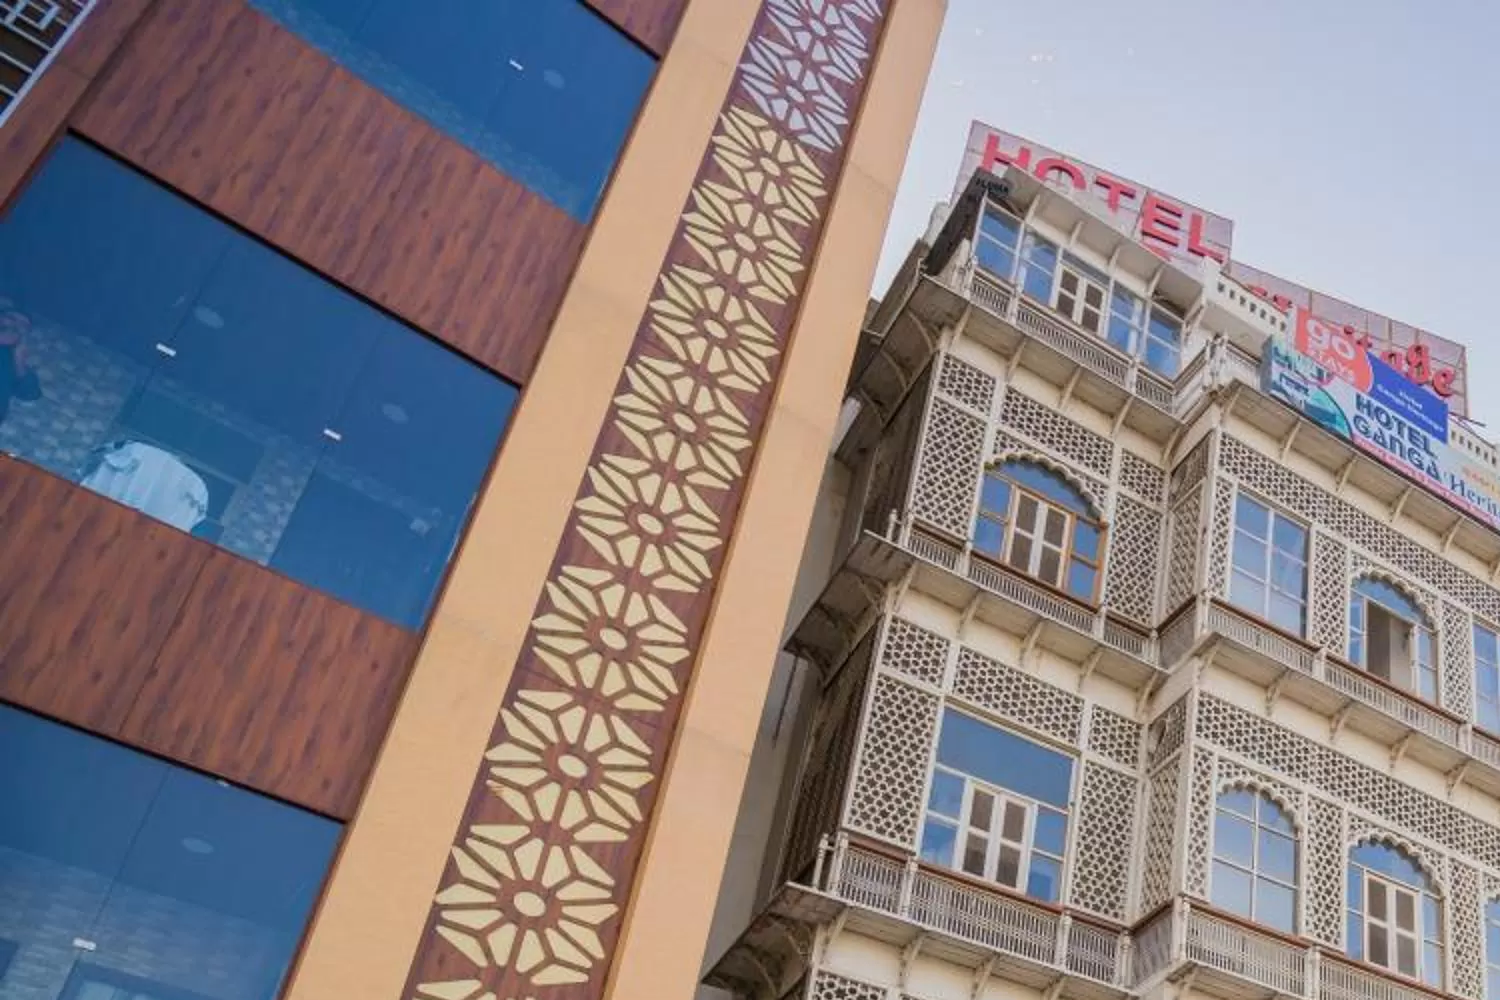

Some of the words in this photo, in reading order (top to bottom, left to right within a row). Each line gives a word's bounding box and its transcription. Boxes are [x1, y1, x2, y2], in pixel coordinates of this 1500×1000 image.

[981, 132, 1228, 266] HOTEL
[1352, 415, 1443, 483] GANGA
[1355, 393, 1438, 459] HOTEL
